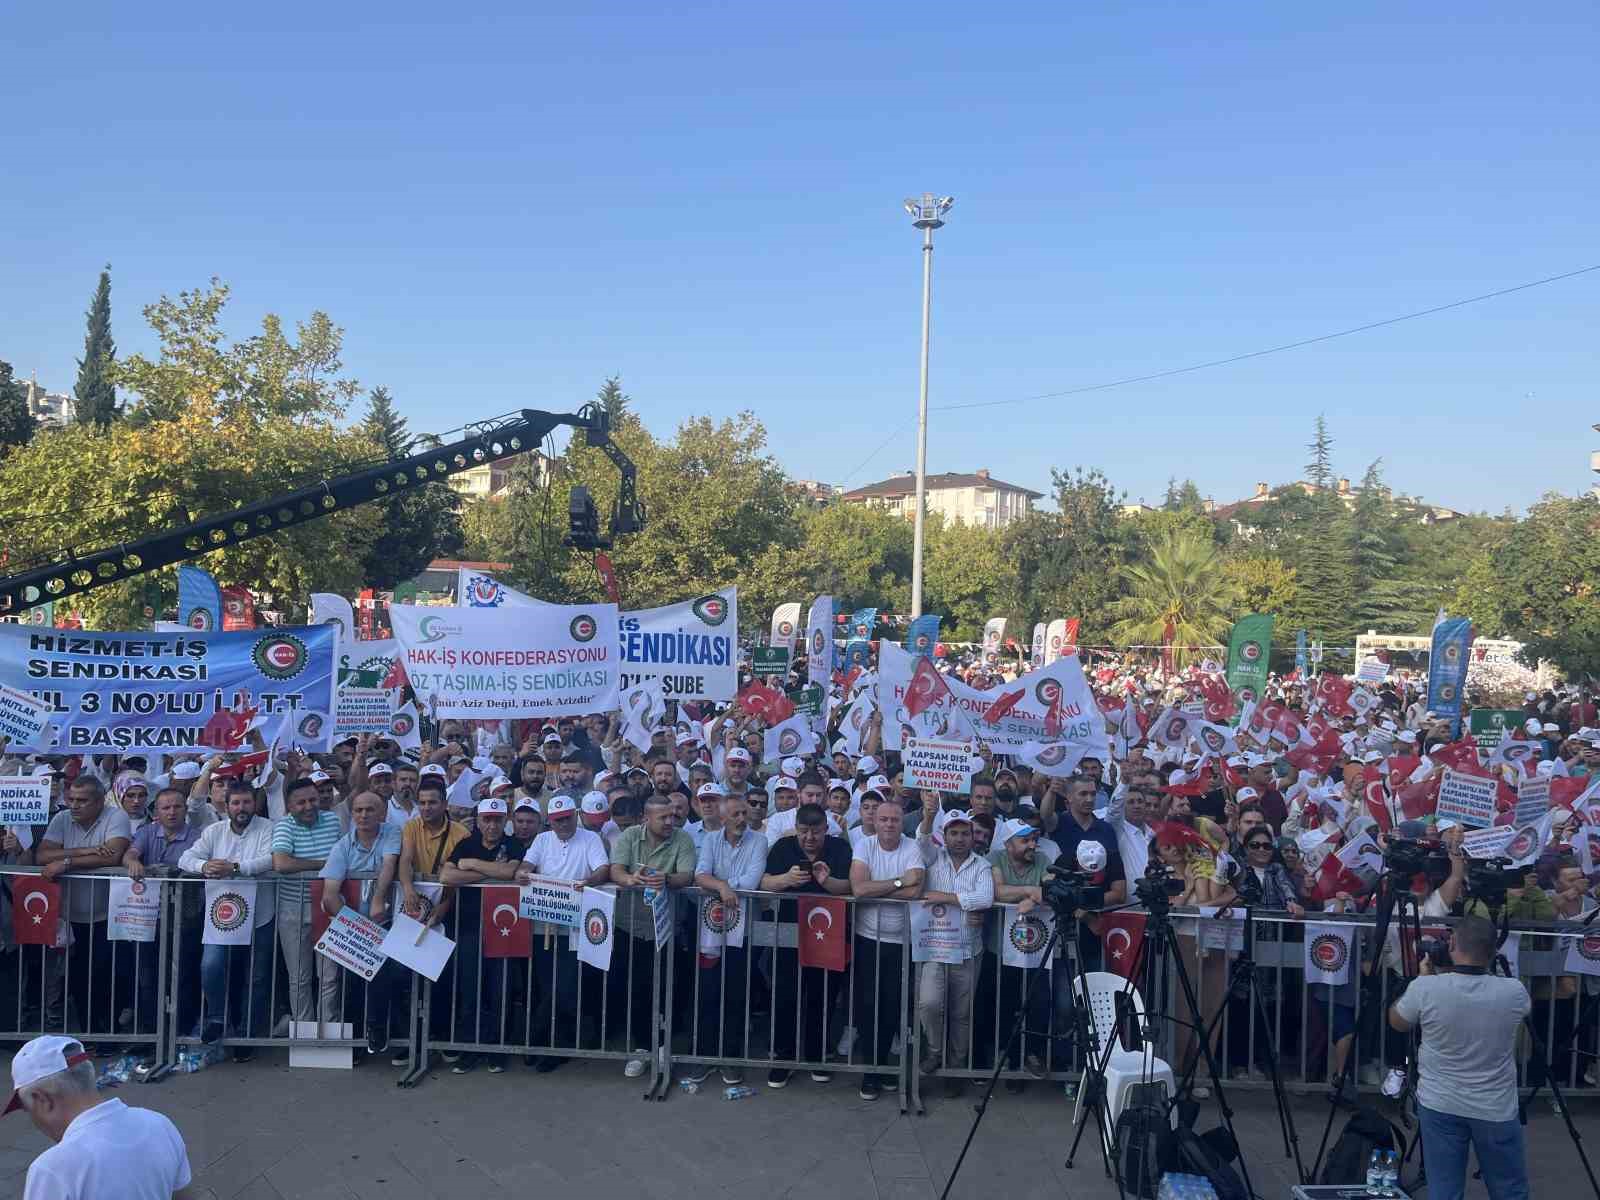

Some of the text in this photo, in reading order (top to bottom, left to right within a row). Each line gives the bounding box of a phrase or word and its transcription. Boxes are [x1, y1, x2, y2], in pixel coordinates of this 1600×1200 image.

[30, 633, 208, 661] HİZMET-İŞ
[407, 646, 608, 672] HAK-İŞ KONFEDERASYONU
[28, 658, 208, 681] SENDİKASI
[412, 672, 430, 690] ÖZ
[433, 671, 517, 695] TAŞIMA-İŞ
[522, 668, 609, 692] SENDİKASI
[661, 674, 705, 697] ŞUBE
[81, 692, 100, 713] 3
[911, 750, 968, 764] KAPSAM DIŞI
[907, 760, 970, 773] KALAN İŞÇİLER
[912, 769, 964, 782] KADROYA
[916, 779, 959, 791] ALINSIN
[0, 787, 42, 798] NDİKAL
[0, 801, 42, 811] SKILAR
[3, 812, 47, 822] BULSUN
[532, 887, 570, 900] REFAHIN
[528, 907, 573, 923] İSTİYORUZ
